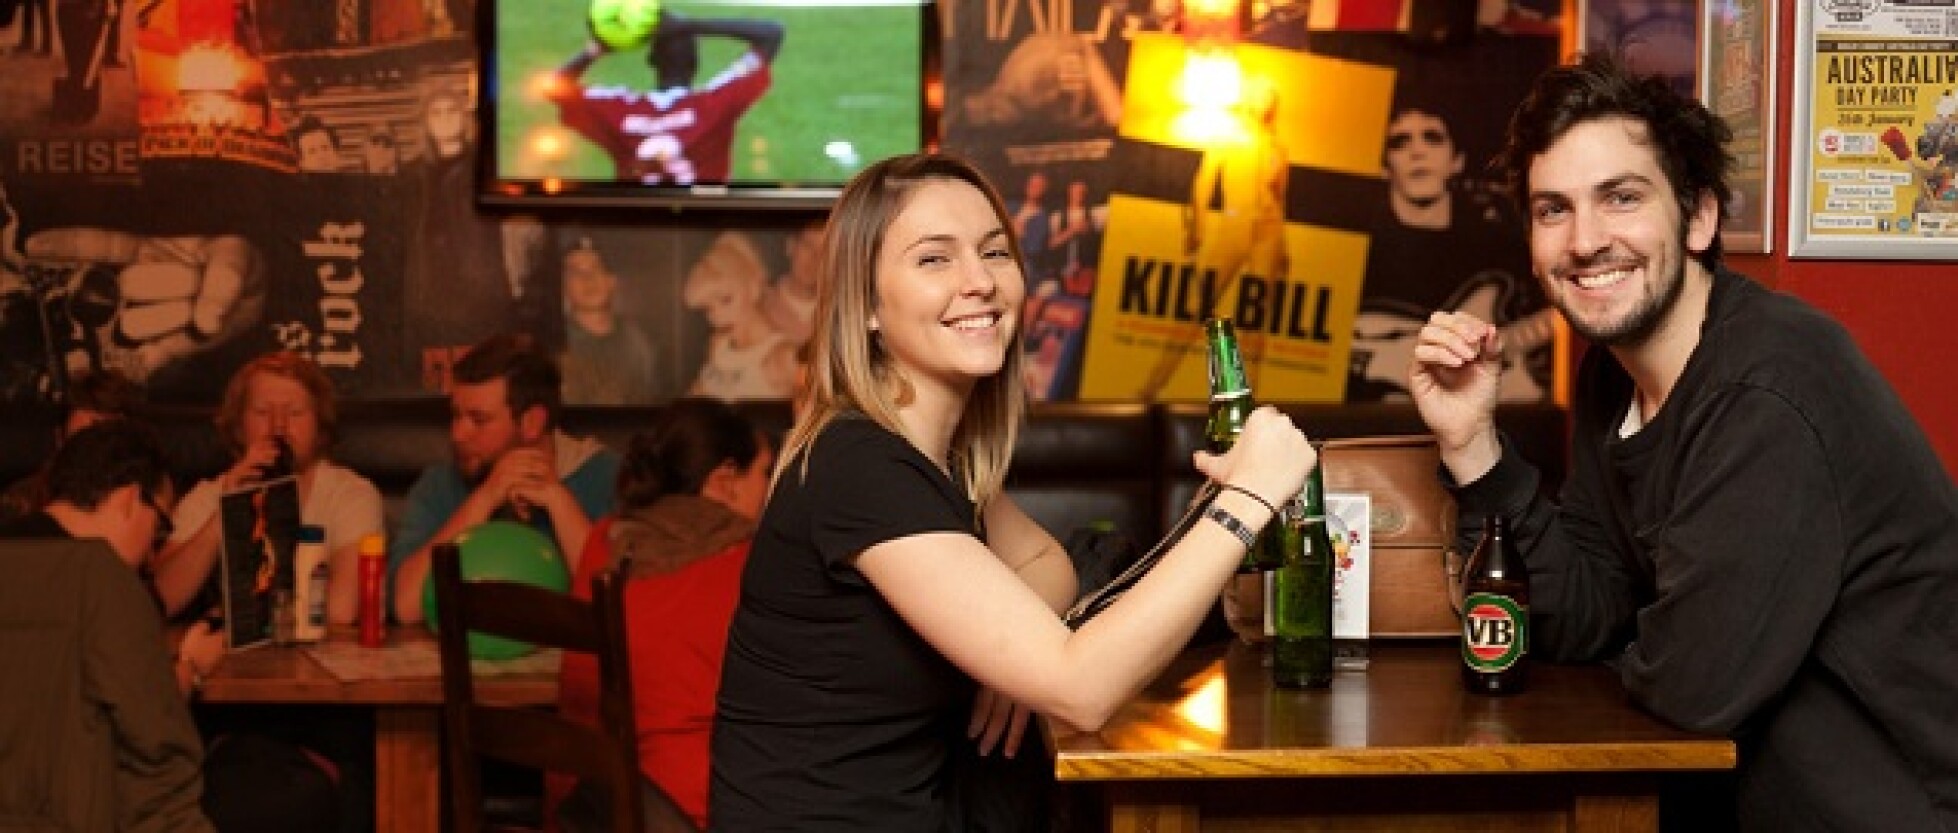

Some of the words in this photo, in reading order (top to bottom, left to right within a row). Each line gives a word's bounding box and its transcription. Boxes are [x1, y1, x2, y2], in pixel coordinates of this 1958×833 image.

[1836, 86, 1865, 105] DAY
[1871, 86, 1918, 105] PARTY
[17, 140, 139, 174] REISE
[302, 221, 364, 369] rock
[1120, 257, 1217, 321] KILL
[1236, 275, 1332, 343] BILL
[1467, 617, 1512, 645] VB
